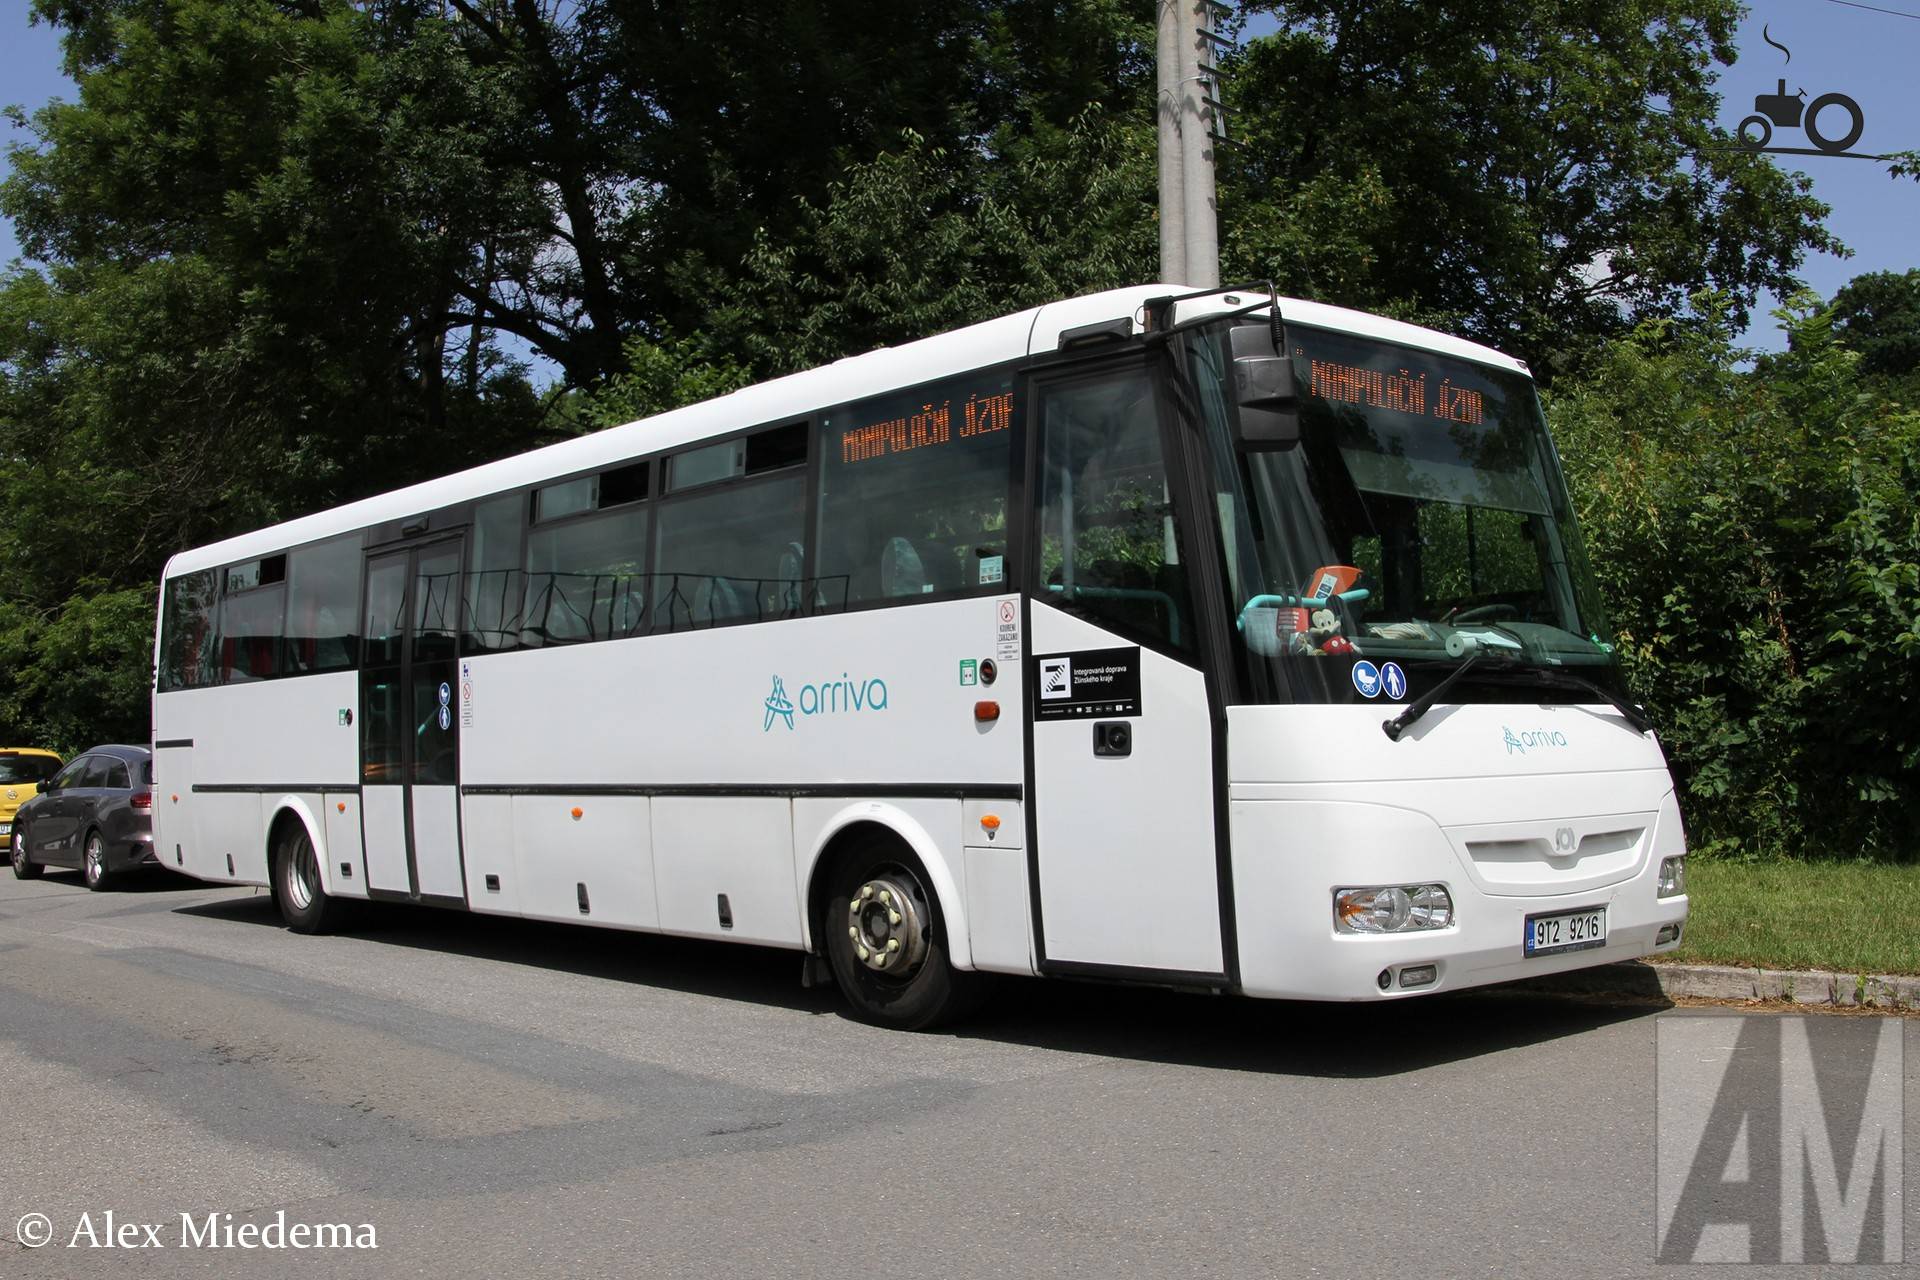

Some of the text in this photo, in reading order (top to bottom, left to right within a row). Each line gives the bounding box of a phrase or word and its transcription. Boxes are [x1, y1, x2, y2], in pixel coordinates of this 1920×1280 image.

[1312, 359, 1482, 424] MANIPULAČNÍ JÍZDA
[843, 400, 950, 463] MANIPULAČNÍ
[1100, 674, 1114, 683] kraje
[1105, 666, 1127, 674] doprava
[799, 672, 888, 715] arriva
[1521, 727, 1568, 747] arriva
[1537, 916, 1599, 945] 9T2 9216
